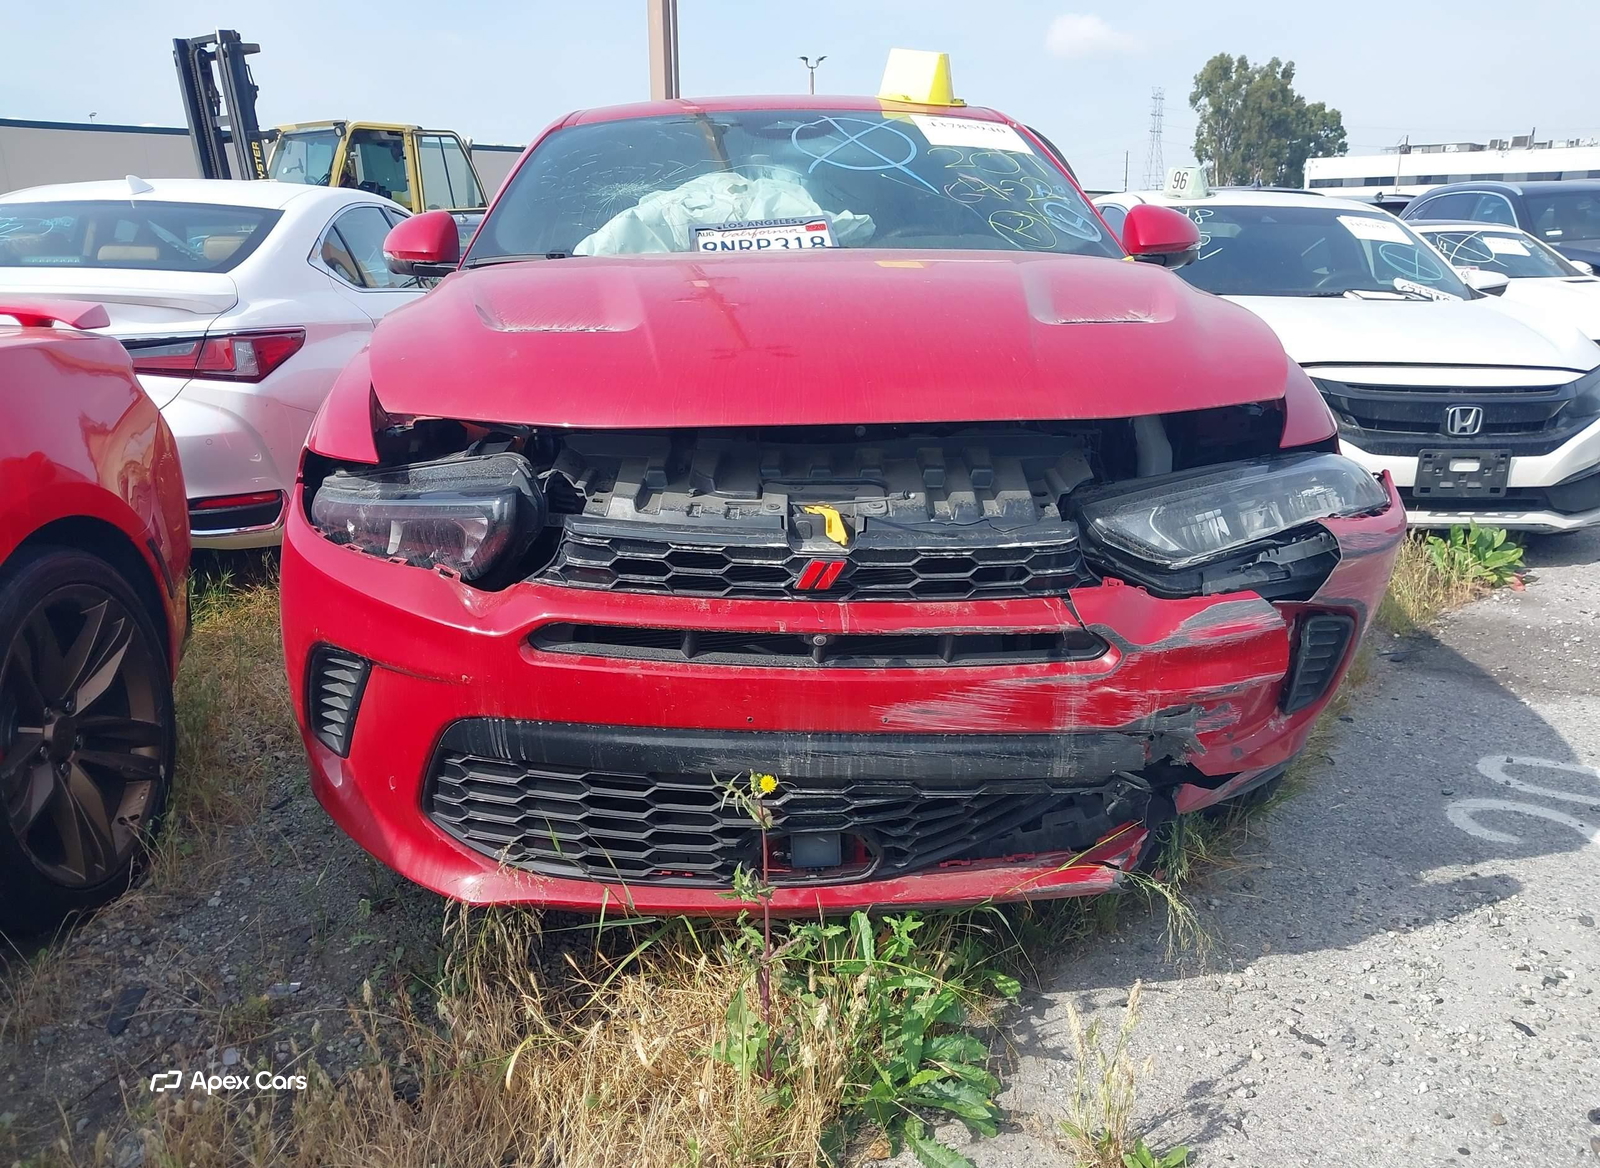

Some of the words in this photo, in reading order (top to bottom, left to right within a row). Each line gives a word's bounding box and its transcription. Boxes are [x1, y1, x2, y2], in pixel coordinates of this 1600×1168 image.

[1172, 171, 1189, 189] 96
[722, 220, 749, 230] LOS
[750, 217, 798, 228] ANGELES
[697, 230, 716, 239] AUG
[721, 226, 807, 239] California
